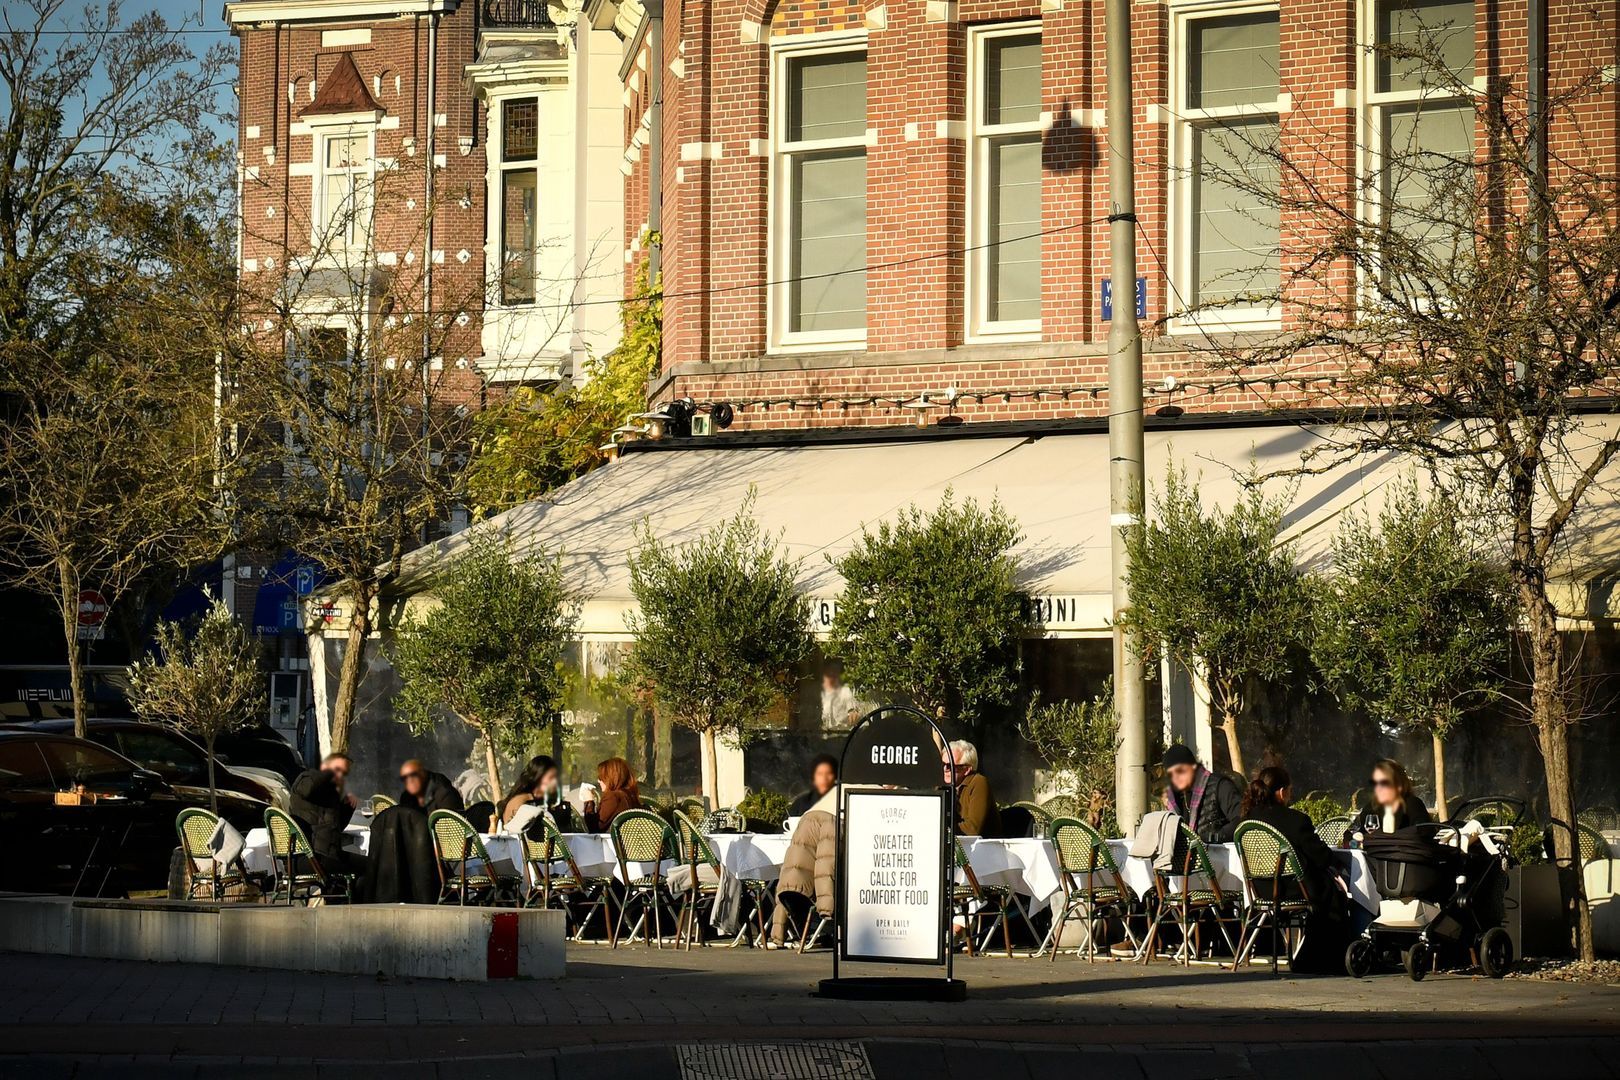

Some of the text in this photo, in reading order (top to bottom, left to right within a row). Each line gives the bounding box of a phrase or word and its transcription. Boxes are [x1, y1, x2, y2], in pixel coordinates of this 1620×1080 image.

[871, 745, 919, 765] GEORGE
[880, 807, 907, 820] GEORGE
[873, 834, 913, 850] SWEATER
[873, 853, 914, 868] WEATHER
[870, 871, 917, 886] CALLS FOR
[859, 889, 929, 905] COMFORT FOOD
[875, 919, 910, 928] OPEN DAILY
